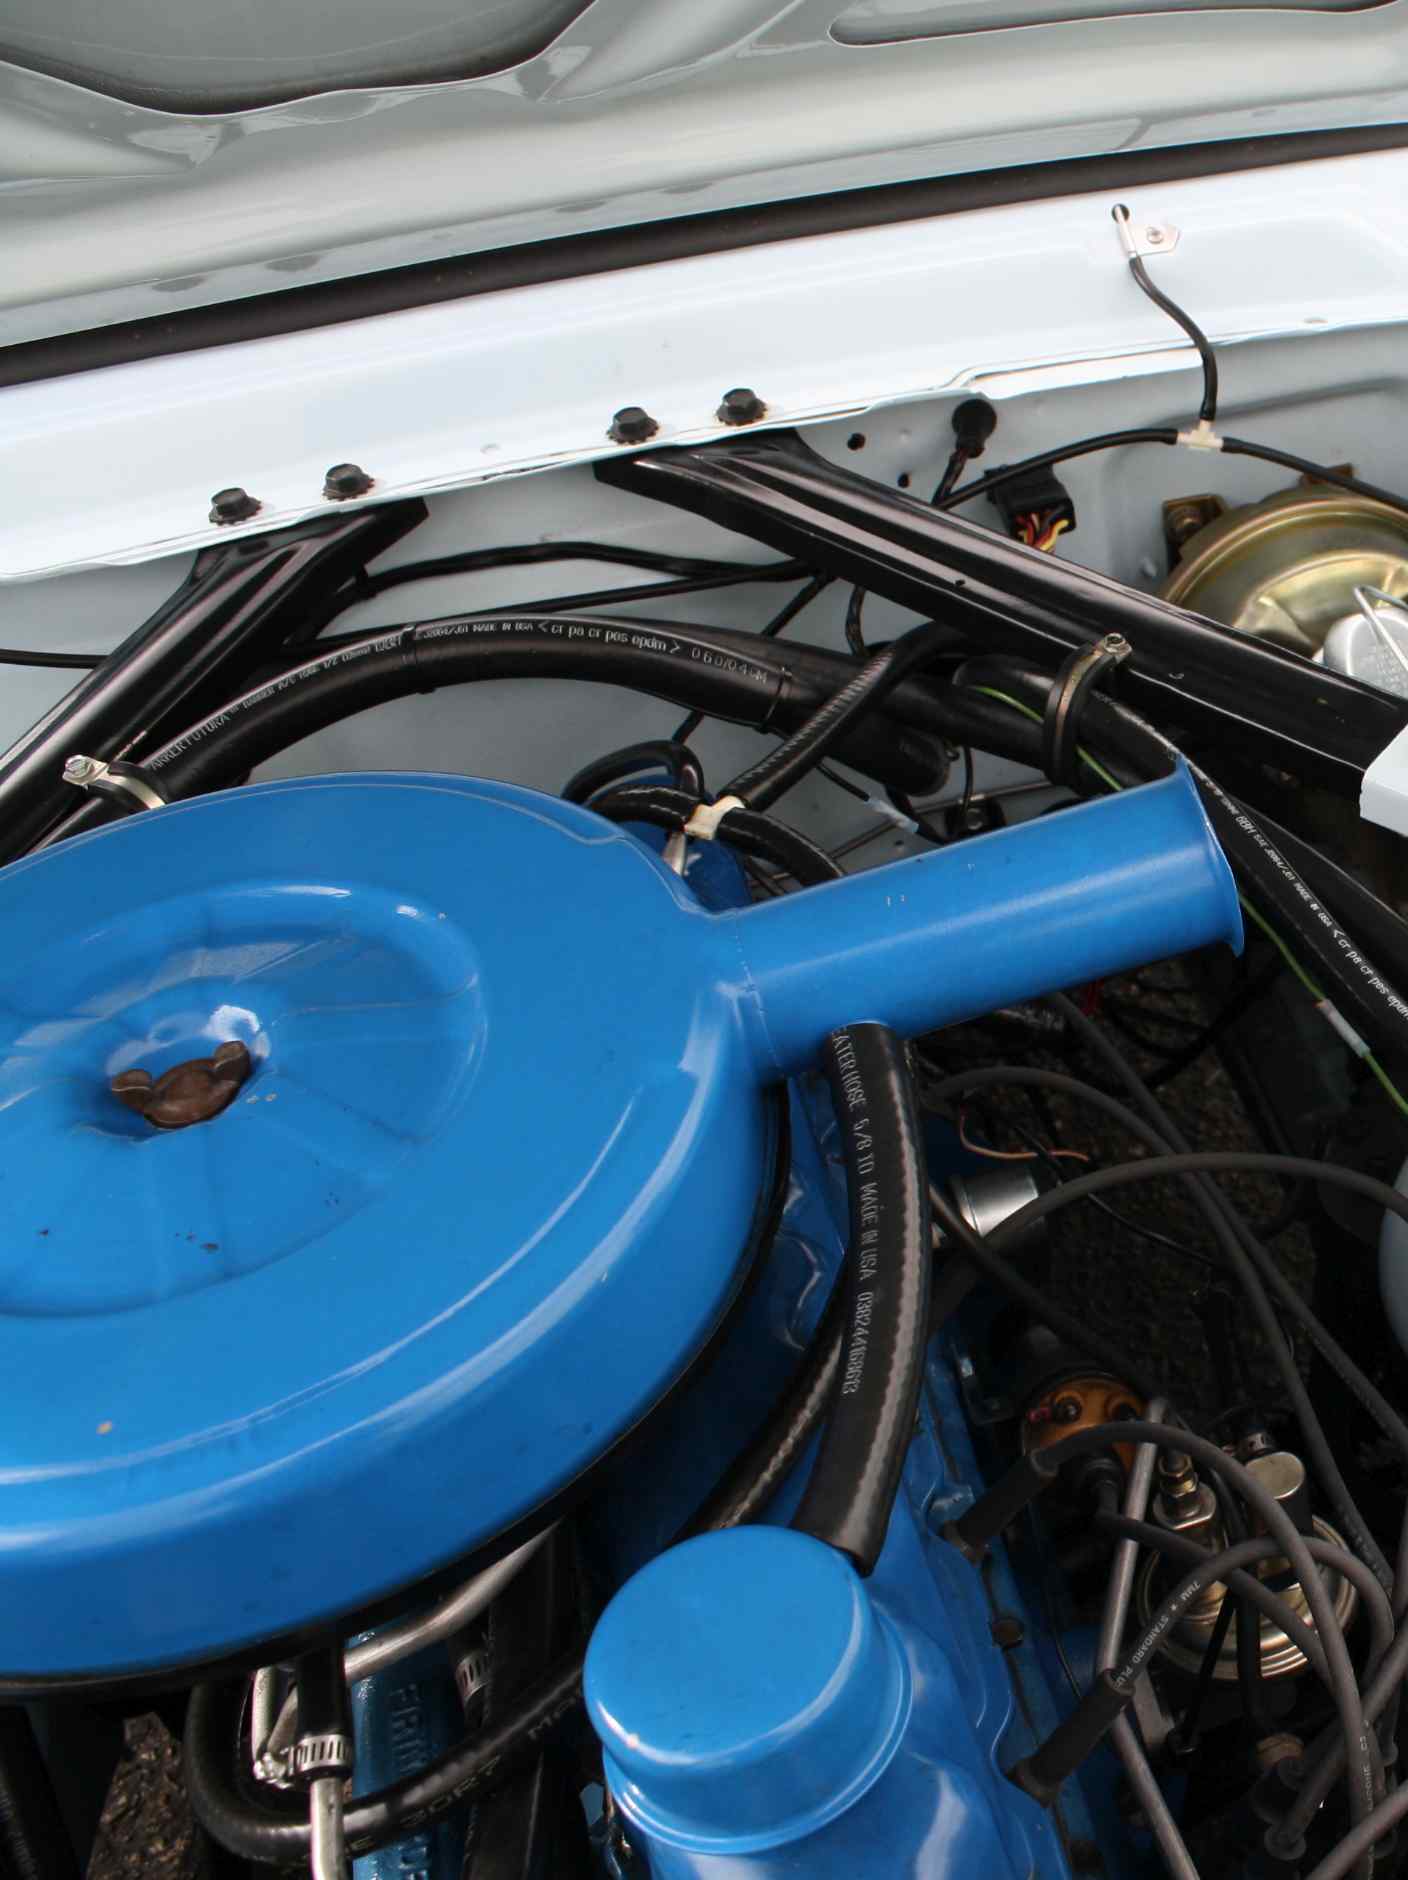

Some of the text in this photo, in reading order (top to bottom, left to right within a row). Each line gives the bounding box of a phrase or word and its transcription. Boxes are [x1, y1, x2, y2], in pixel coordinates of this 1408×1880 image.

[860, 1181, 880, 1228] MADE
[858, 1248, 878, 1281] USA
[1132, 1614, 1169, 1664] STANDARD
